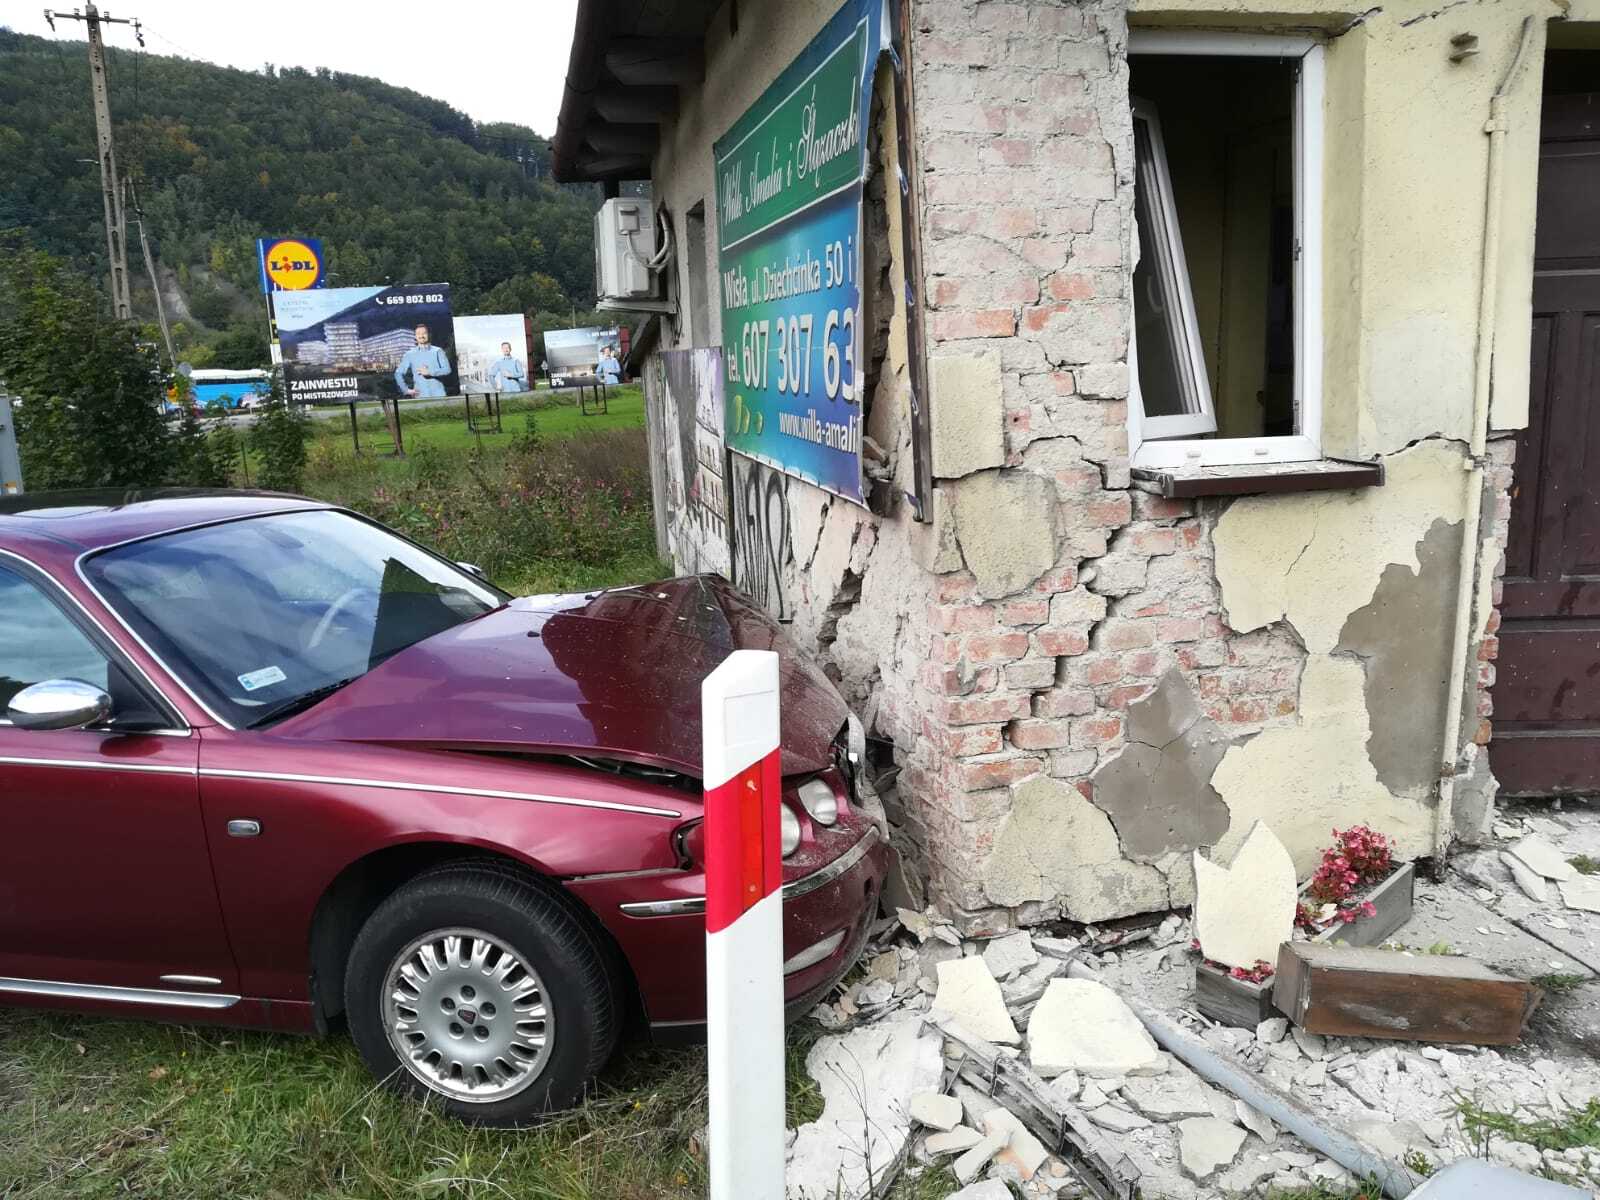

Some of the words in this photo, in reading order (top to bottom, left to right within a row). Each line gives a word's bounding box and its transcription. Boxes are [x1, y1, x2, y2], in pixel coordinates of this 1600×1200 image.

[746, 136, 782, 213] Amalia
[786, 142, 793, 187] i
[751, 268, 761, 304] ul.
[763, 249, 820, 301] Dziechcinka
[825, 240, 844, 288] 50
[386, 295, 405, 305] 669
[406, 295, 425, 304] 802
[425, 294, 444, 303] 802
[727, 342, 740, 382] tel.
[742, 319, 769, 389] 607
[777, 313, 813, 395] 307
[823, 307, 855, 400] 63
[291, 377, 358, 390] ZAINWESTUJ
[291, 392, 303, 400] PO
[303, 390, 359, 400] MISTRZOWSKU
